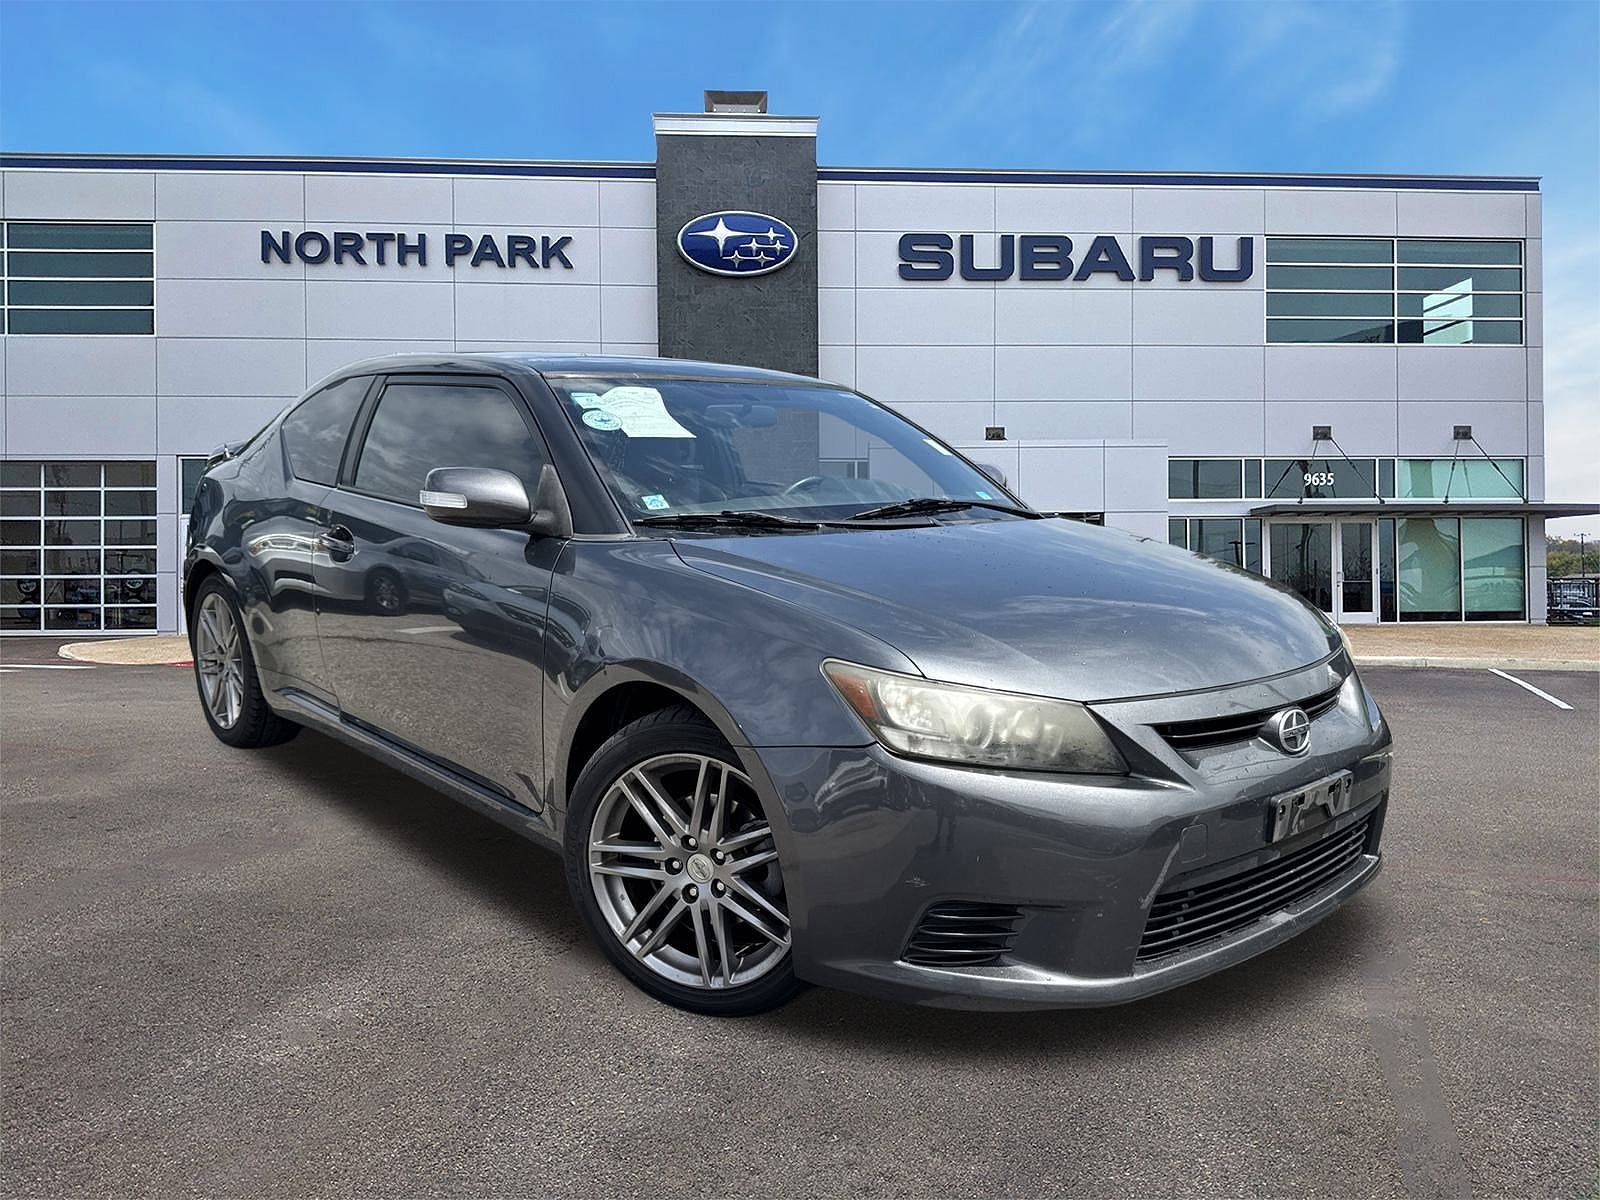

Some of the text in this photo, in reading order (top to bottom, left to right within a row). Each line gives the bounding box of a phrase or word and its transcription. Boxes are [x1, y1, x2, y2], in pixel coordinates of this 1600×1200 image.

[260, 230, 574, 269] NORTH PARK
[898, 232, 1254, 283] SUBARU
[1303, 472, 1335, 487] 9635
